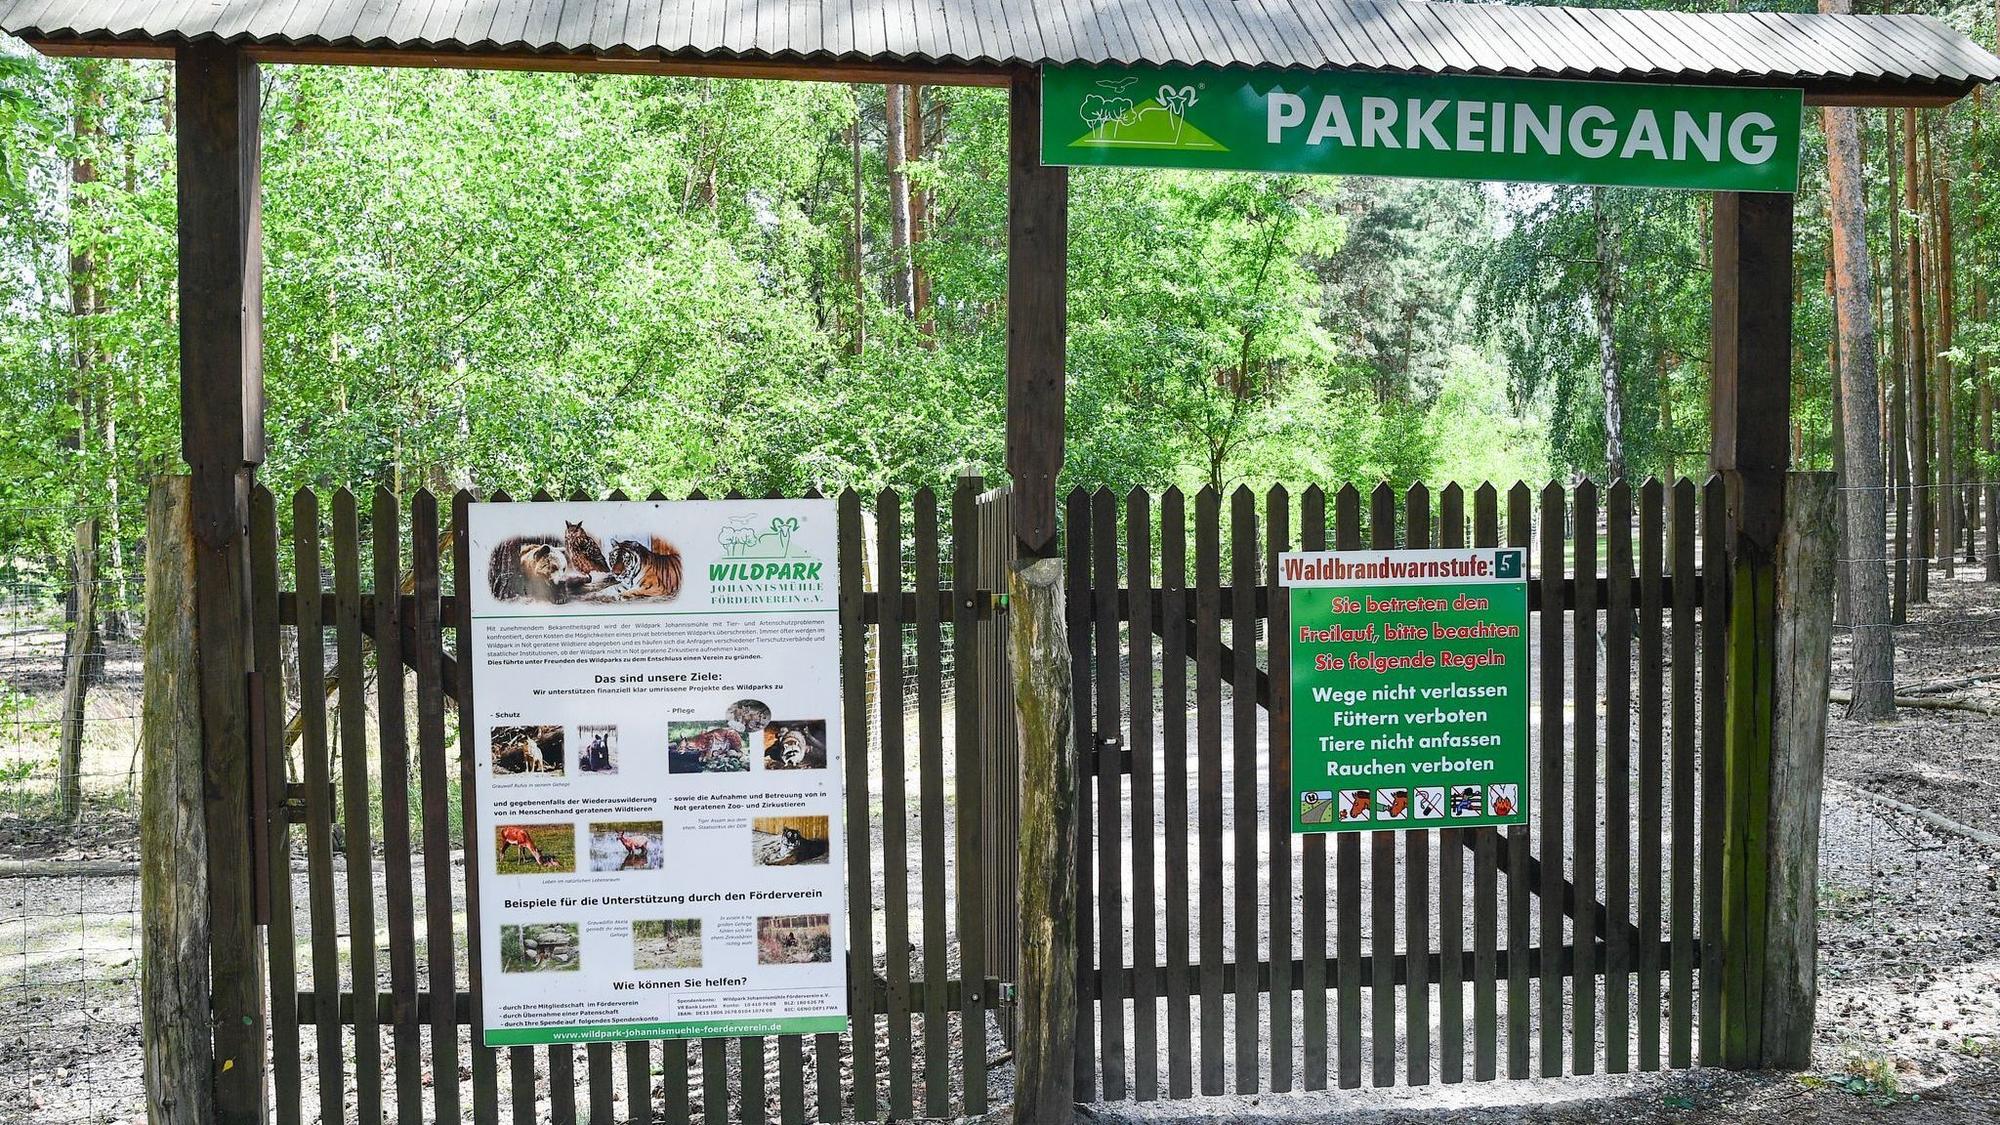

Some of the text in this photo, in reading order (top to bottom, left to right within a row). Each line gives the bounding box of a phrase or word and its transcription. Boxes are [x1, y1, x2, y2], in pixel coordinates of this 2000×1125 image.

[1266, 92, 1778, 165] PARKEINGANG
[709, 563, 823, 581] WILDPARK
[1285, 555, 1512, 580] Waldbrandwarnstufe: 5
[710, 581, 823, 593] JOHANNISMÜHLE
[711, 593, 800, 604] FÖRDERVEREIN
[1332, 594, 1488, 613] Sie betreten den
[1299, 621, 1519, 643] Freilauf, bitte beachten
[1315, 649, 1505, 673] Sie folgende Regeln
[595, 675, 616, 683] Das
[620, 674, 644, 683] sind
[691, 672, 722, 681] Ziele:
[1312, 682, 1507, 705] Wege nicht verlassen
[1334, 708, 1487, 726] Füttern verboten
[1319, 732, 1501, 751] Tiere nicht anfassen
[1327, 757, 1494, 776] Rauchen verboten
[510, 799, 565, 808] gegebenenfalls
[519, 808, 573, 816] Menschenhand
[575, 807, 612, 815] geratenen
[689, 804, 725, 812] geratenen
[505, 889, 822, 910] Beispiele für die Unterstützung durch den Förderverein
[613, 977, 747, 990] Wie können Sie helfen?
[539, 1002, 584, 1010] Mitgliedschaft
[540, 1019, 564, 1027] Spende
[612, 1015, 658, 1024] Spendenkonto
[553, 1023, 781, 1039] www.wildpark-johannismuehle-foerderverein.de
